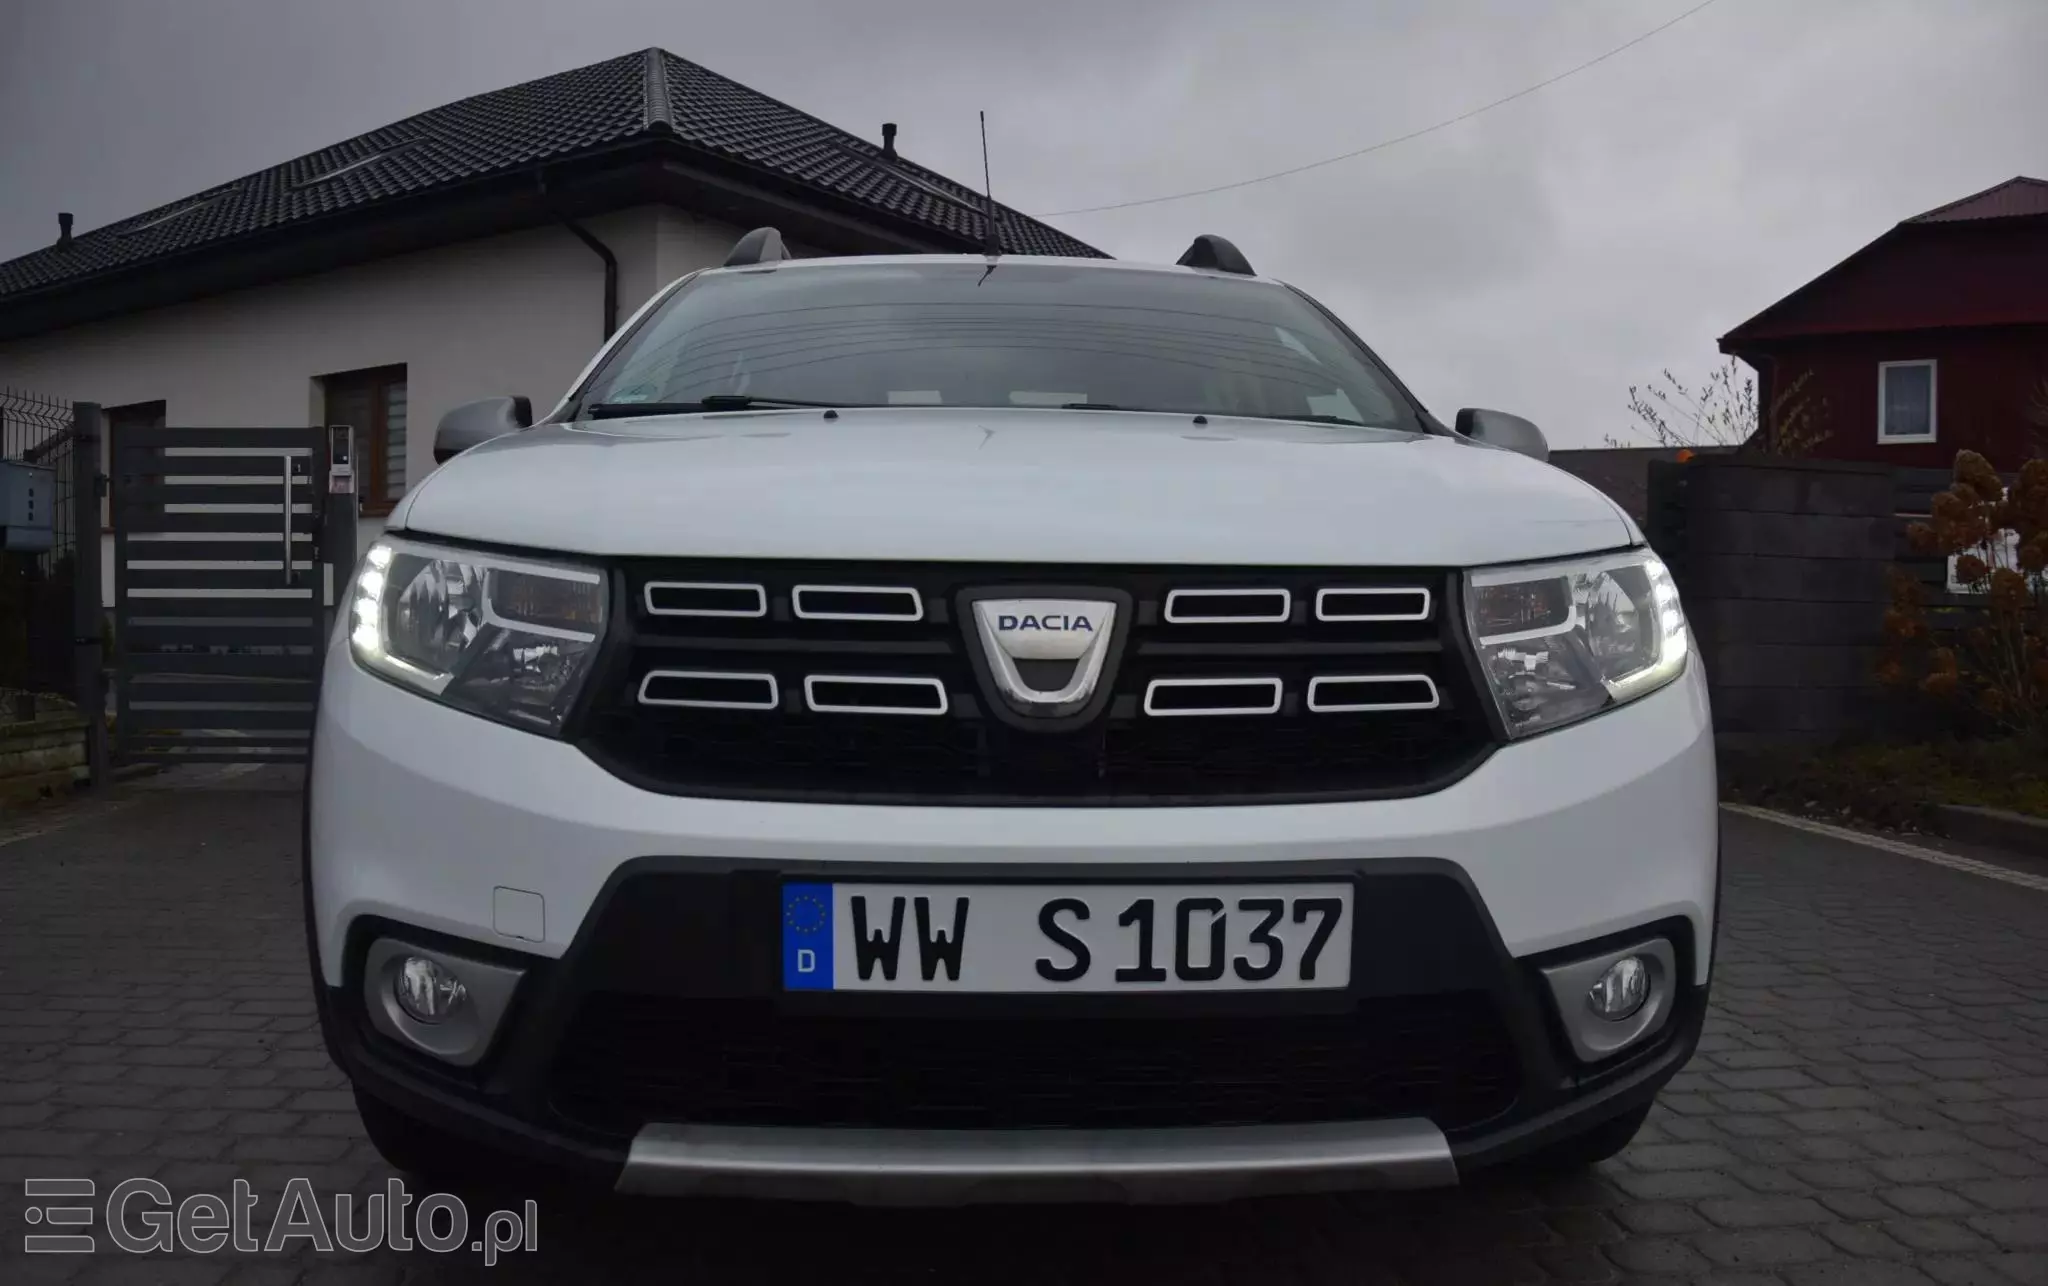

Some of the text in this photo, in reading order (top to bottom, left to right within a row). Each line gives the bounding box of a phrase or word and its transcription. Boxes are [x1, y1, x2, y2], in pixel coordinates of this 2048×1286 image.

[998, 615, 1093, 631] DACIA
[850, 895, 970, 981] WW
[797, 949, 815, 973] D
